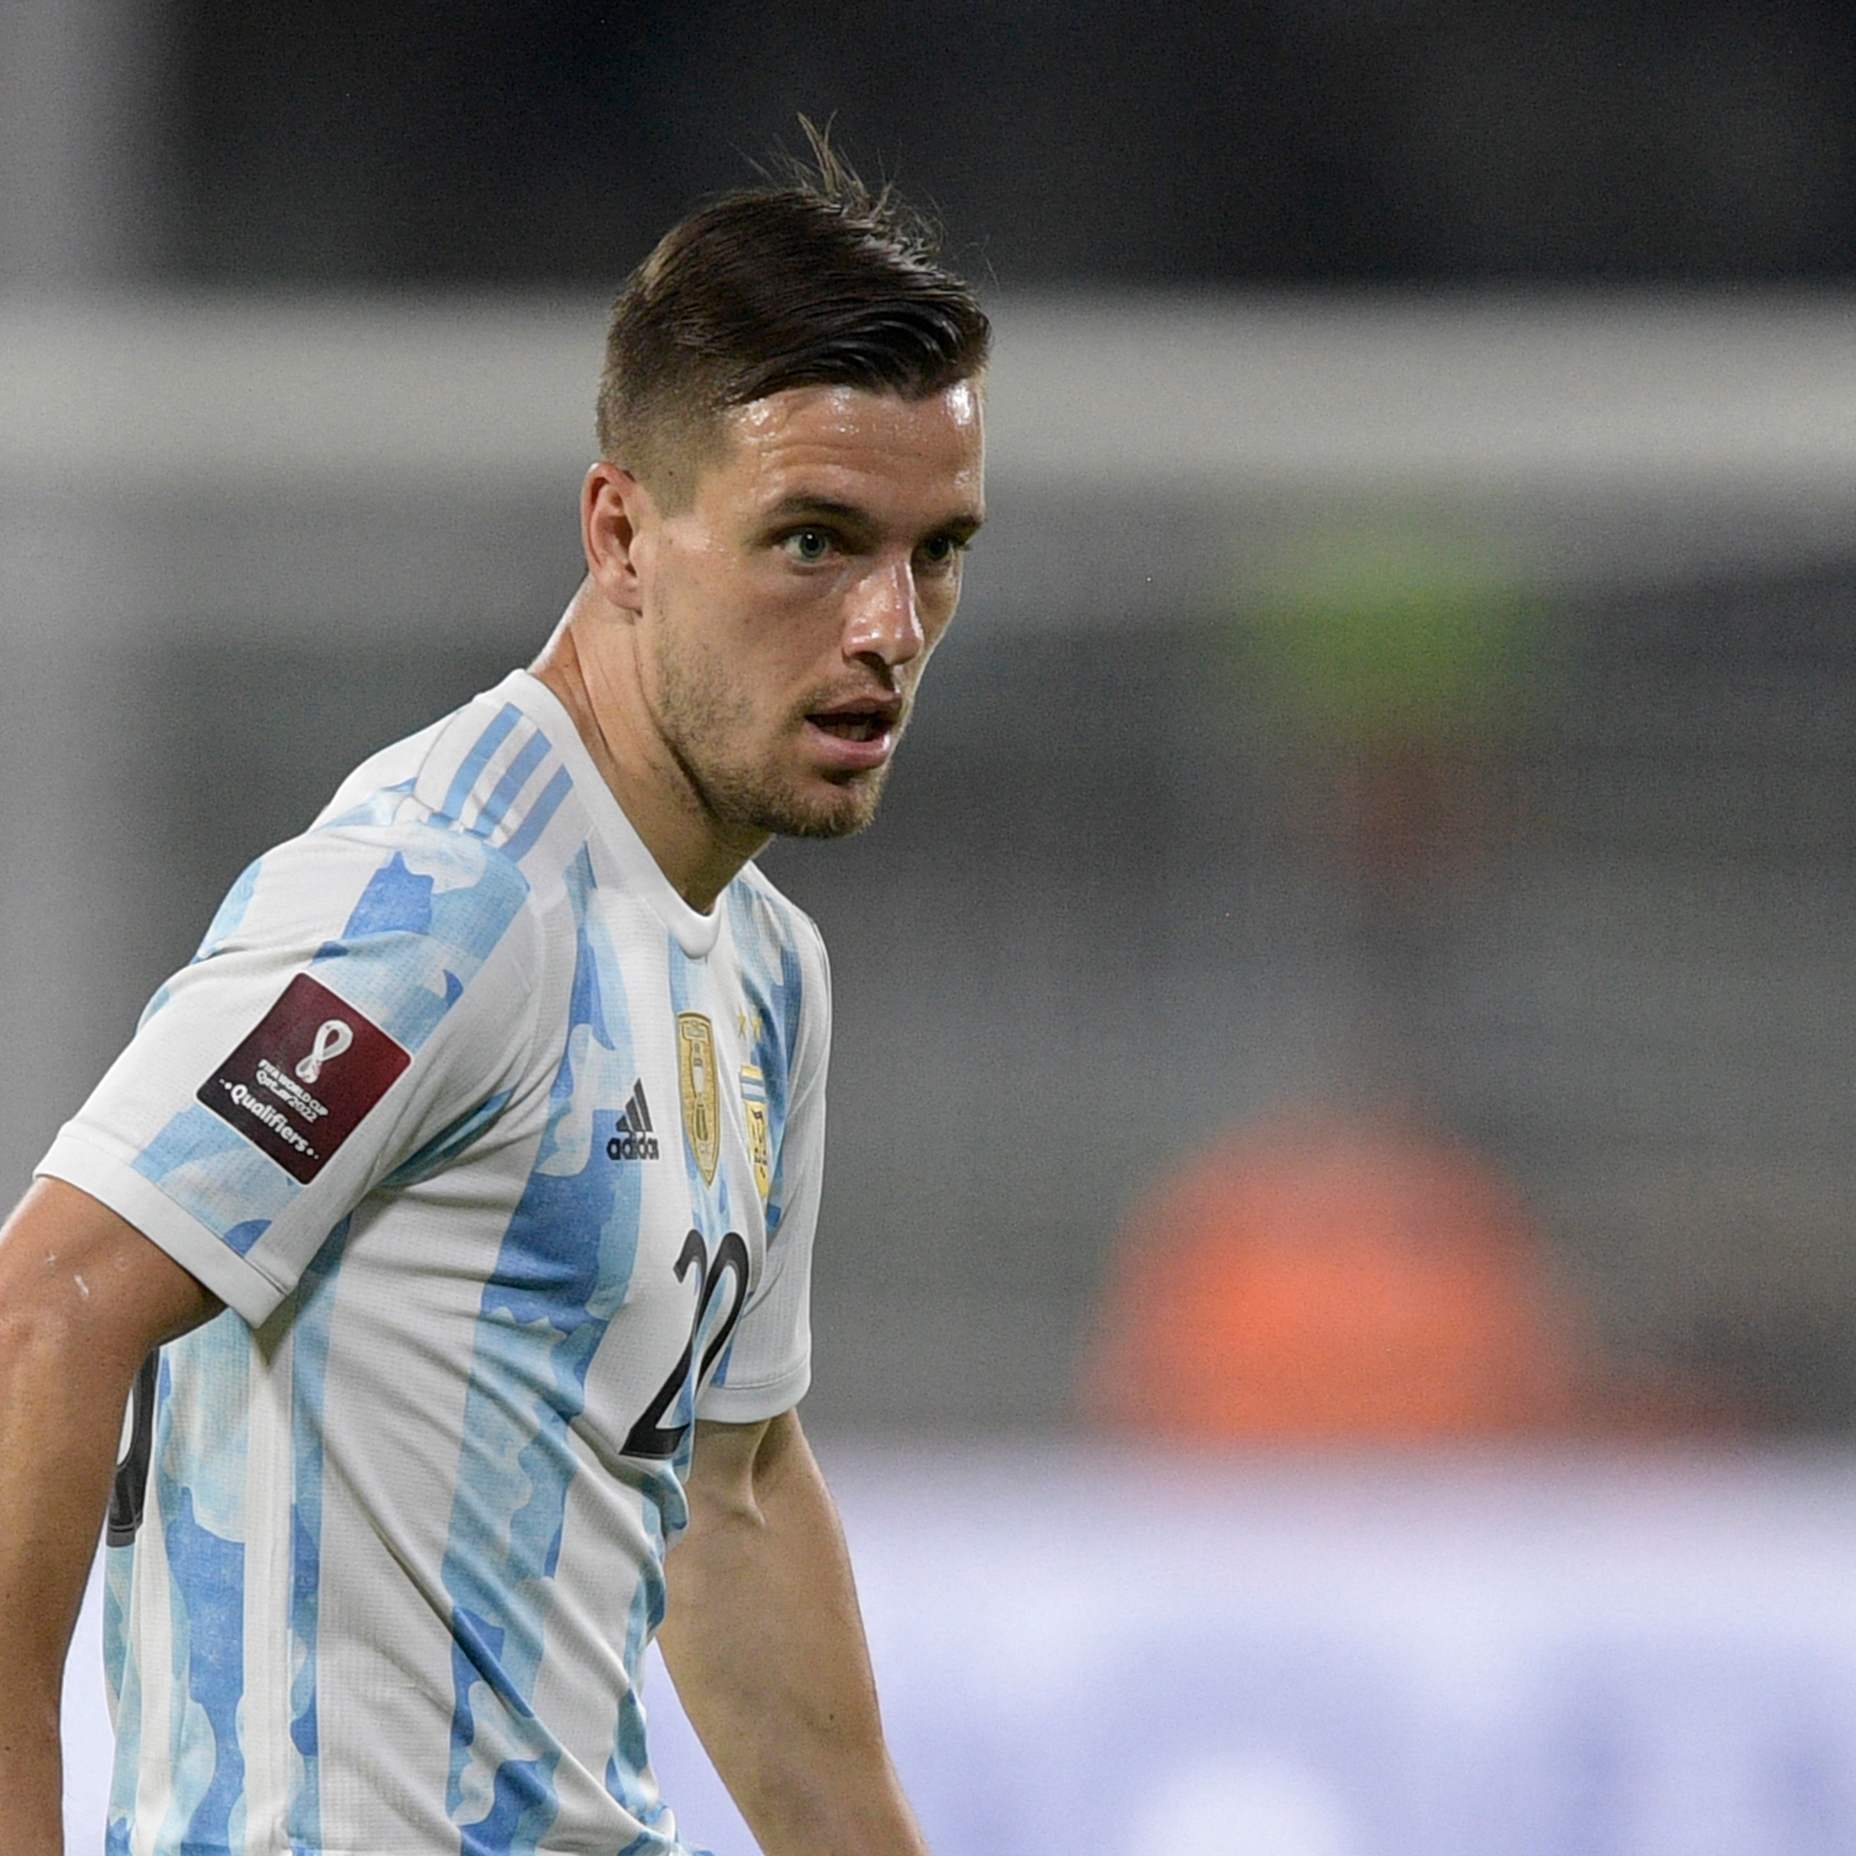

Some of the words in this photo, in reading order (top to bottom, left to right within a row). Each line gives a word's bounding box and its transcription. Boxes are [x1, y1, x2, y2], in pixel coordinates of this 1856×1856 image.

[230, 1083, 309, 1153] Qualifiers
[277, 1073, 311, 1104] WORLD
[308, 1098, 329, 1117] CUP
